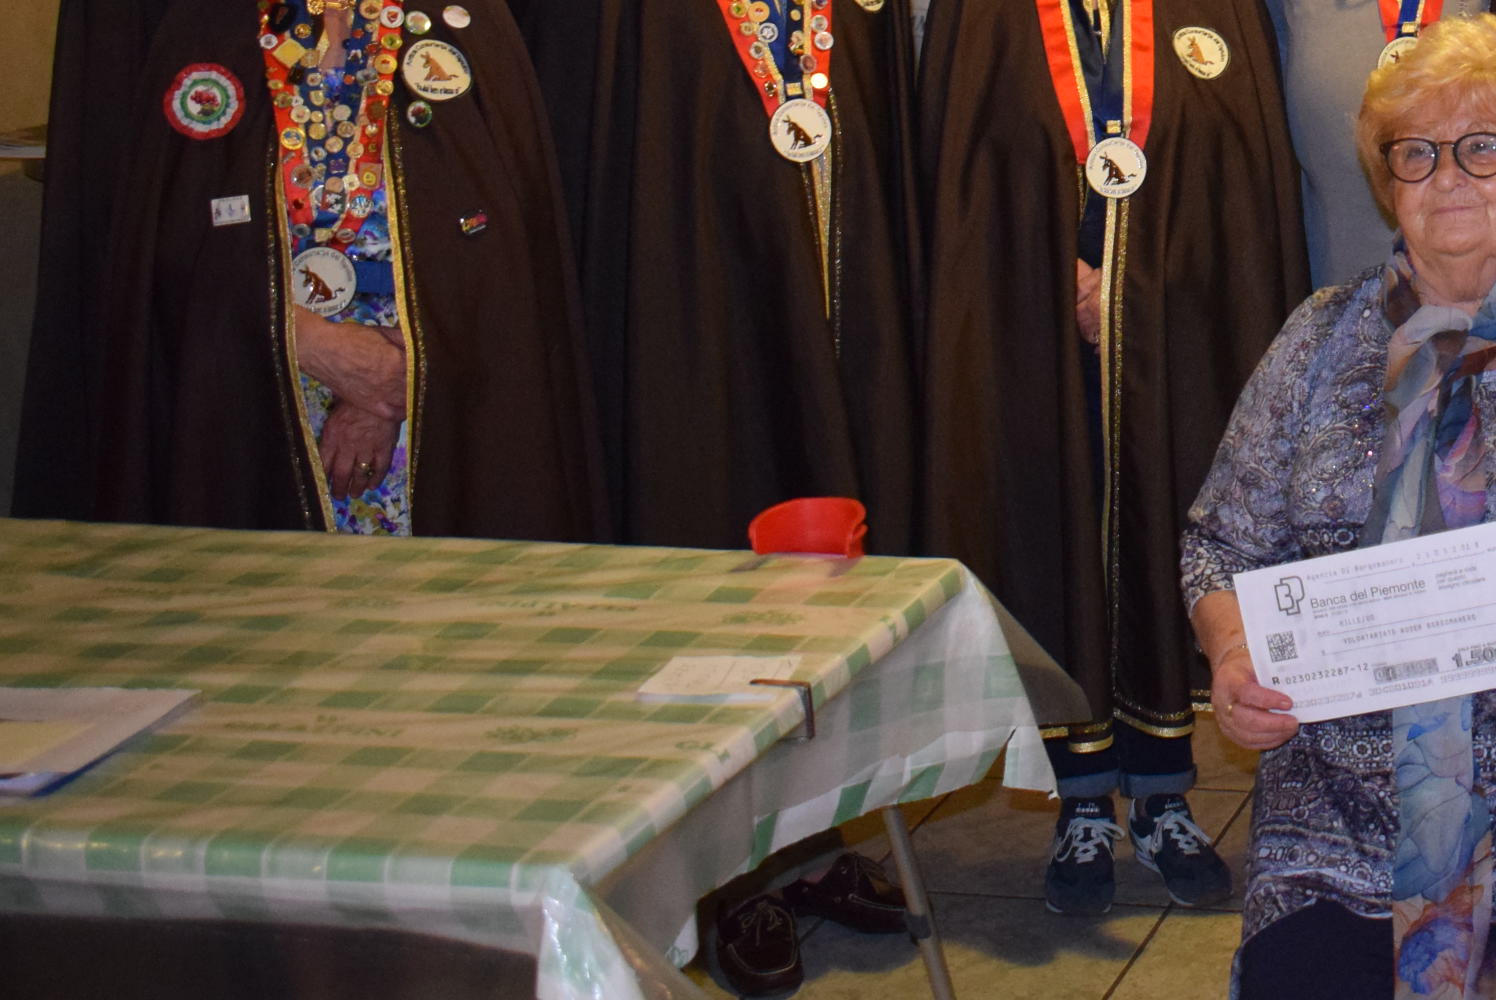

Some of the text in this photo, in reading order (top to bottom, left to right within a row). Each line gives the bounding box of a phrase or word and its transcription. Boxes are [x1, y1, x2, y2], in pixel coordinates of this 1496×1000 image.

[1309, 594, 1348, 610] Banca
[1350, 590, 1367, 603] del
[1370, 578, 1427, 600] Piemonte
[1272, 676, 1281, 686] R
